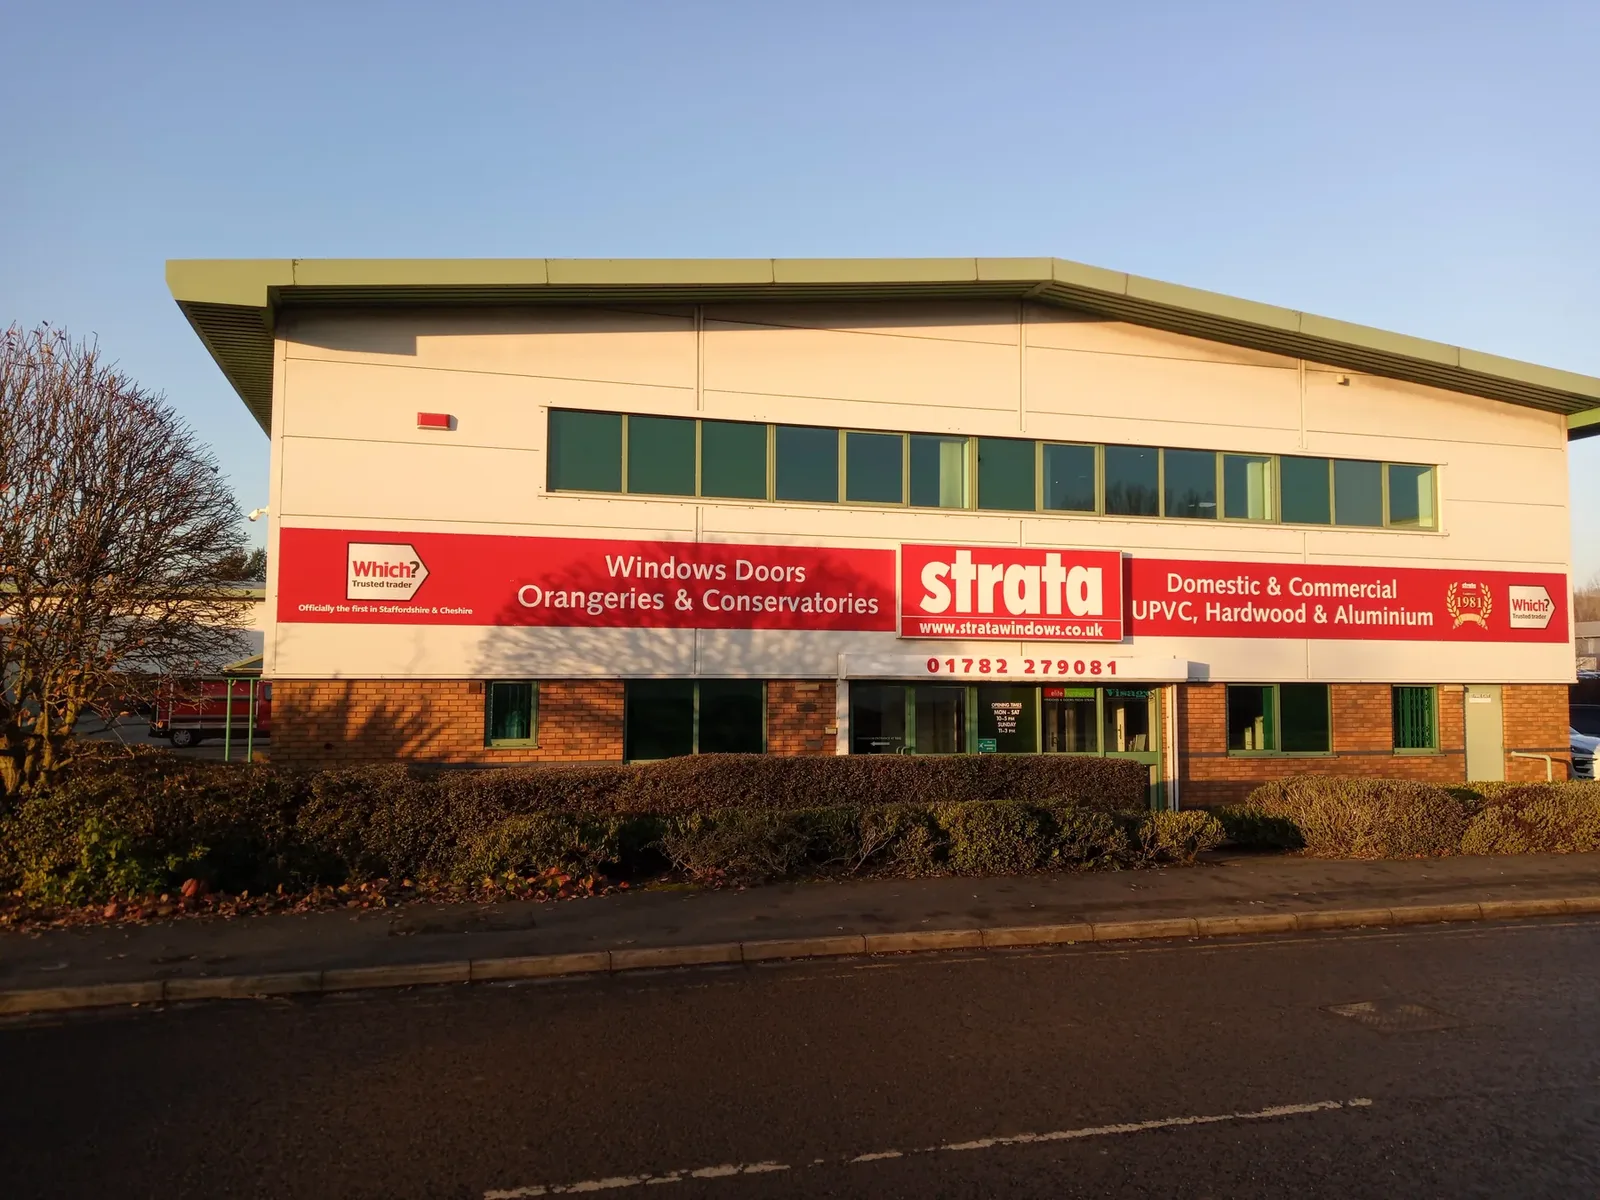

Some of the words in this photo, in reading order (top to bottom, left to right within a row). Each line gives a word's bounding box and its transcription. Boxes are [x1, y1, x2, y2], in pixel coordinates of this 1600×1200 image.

[352, 560, 420, 579] Which?
[604, 554, 726, 581] Windows
[735, 559, 806, 583] Doors
[352, 580, 385, 588] Trusted
[386, 581, 413, 589] trader
[919, 549, 1103, 617] strata
[1167, 572, 1261, 596] Domestic
[1267, 576, 1282, 597] &
[1288, 576, 1398, 599] Commercial
[517, 584, 665, 616] Orangeries
[674, 588, 693, 611] &
[702, 588, 879, 615] Conservatories
[1456, 596, 1483, 608] 1981
[1512, 598, 1550, 612] Which?
[298, 604, 335, 614] Officially
[336, 605, 350, 613] the
[352, 605, 368, 613] first
[379, 605, 430, 614] Staffordshire
[440, 607, 473, 615] Cheshire
[1132, 600, 1199, 624] UPVC,
[1205, 602, 1307, 624] Hardwood
[1313, 603, 1328, 624] &
[1334, 604, 1434, 626] Aluminium
[919, 621, 1103, 637] www.stratawindows.co.uk
[927, 657, 1008, 674] 01782
[1024, 659, 1117, 675] 279081
